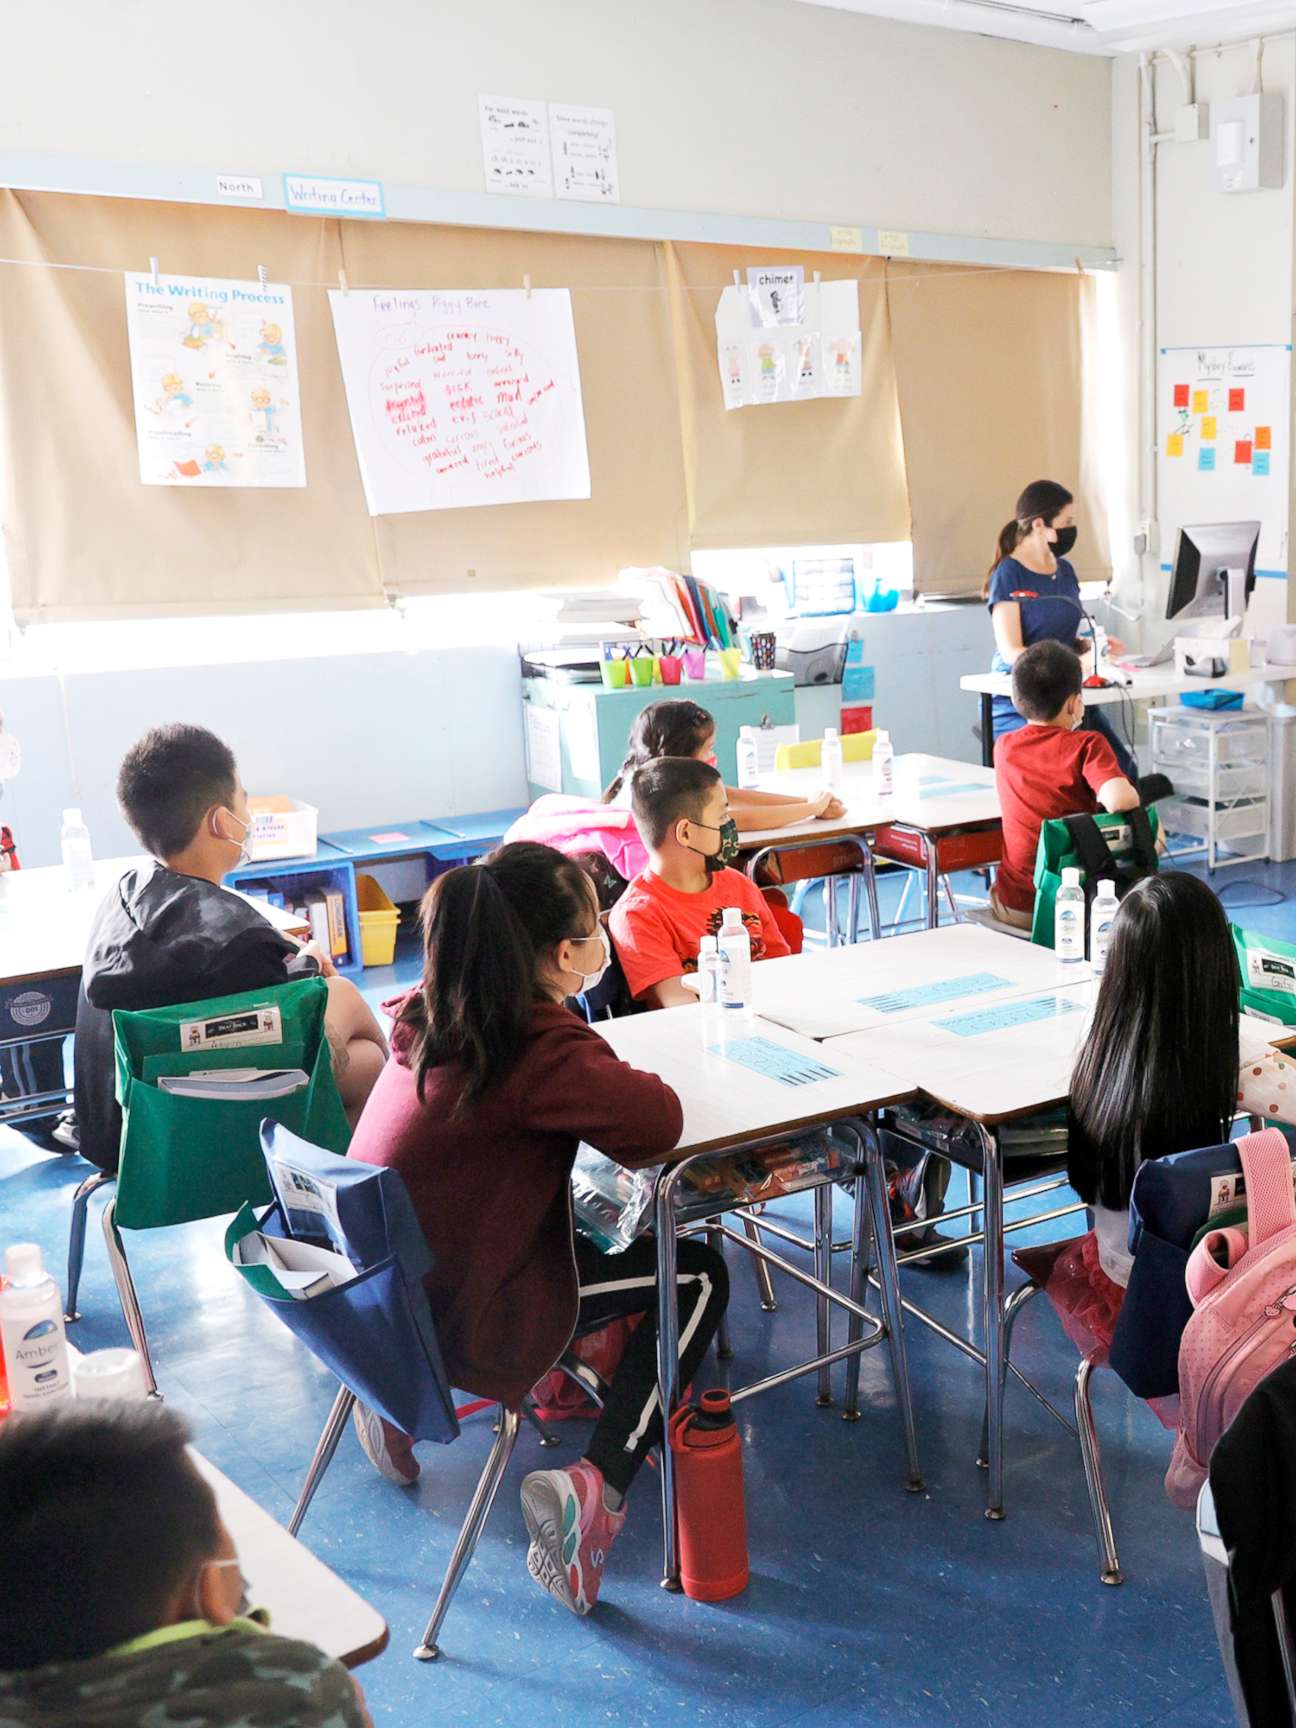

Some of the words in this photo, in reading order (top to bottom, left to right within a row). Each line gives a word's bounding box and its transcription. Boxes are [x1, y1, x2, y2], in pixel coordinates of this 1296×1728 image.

[218, 181, 254, 193] North
[135, 281, 165, 296] The
[167, 284, 229, 303] Writing
[232, 288, 285, 304] Process
